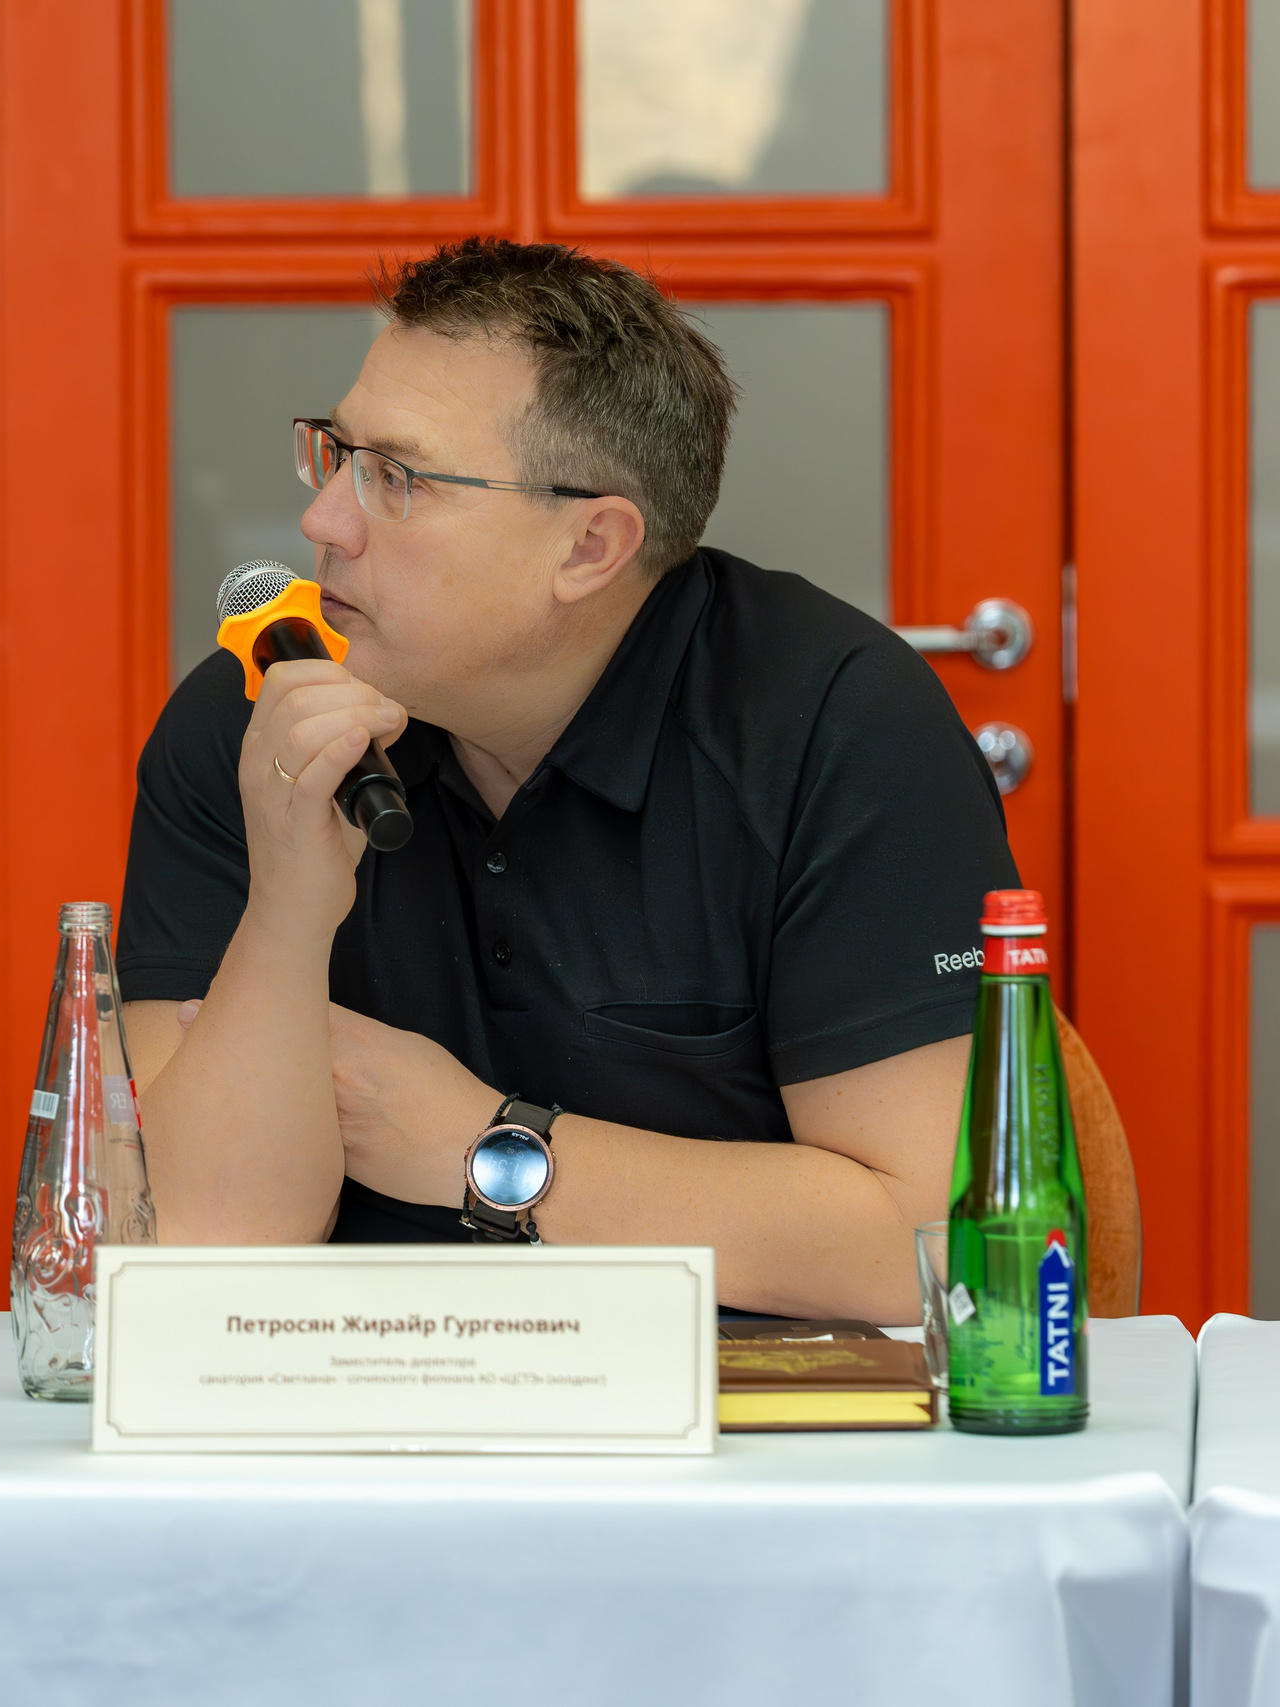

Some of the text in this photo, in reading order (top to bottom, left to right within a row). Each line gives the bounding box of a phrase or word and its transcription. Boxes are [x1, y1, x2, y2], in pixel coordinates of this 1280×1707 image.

[226, 1314, 581, 1338] Петросян Жирайр Гургенович
[1047, 1282, 1070, 1387] TATNI
